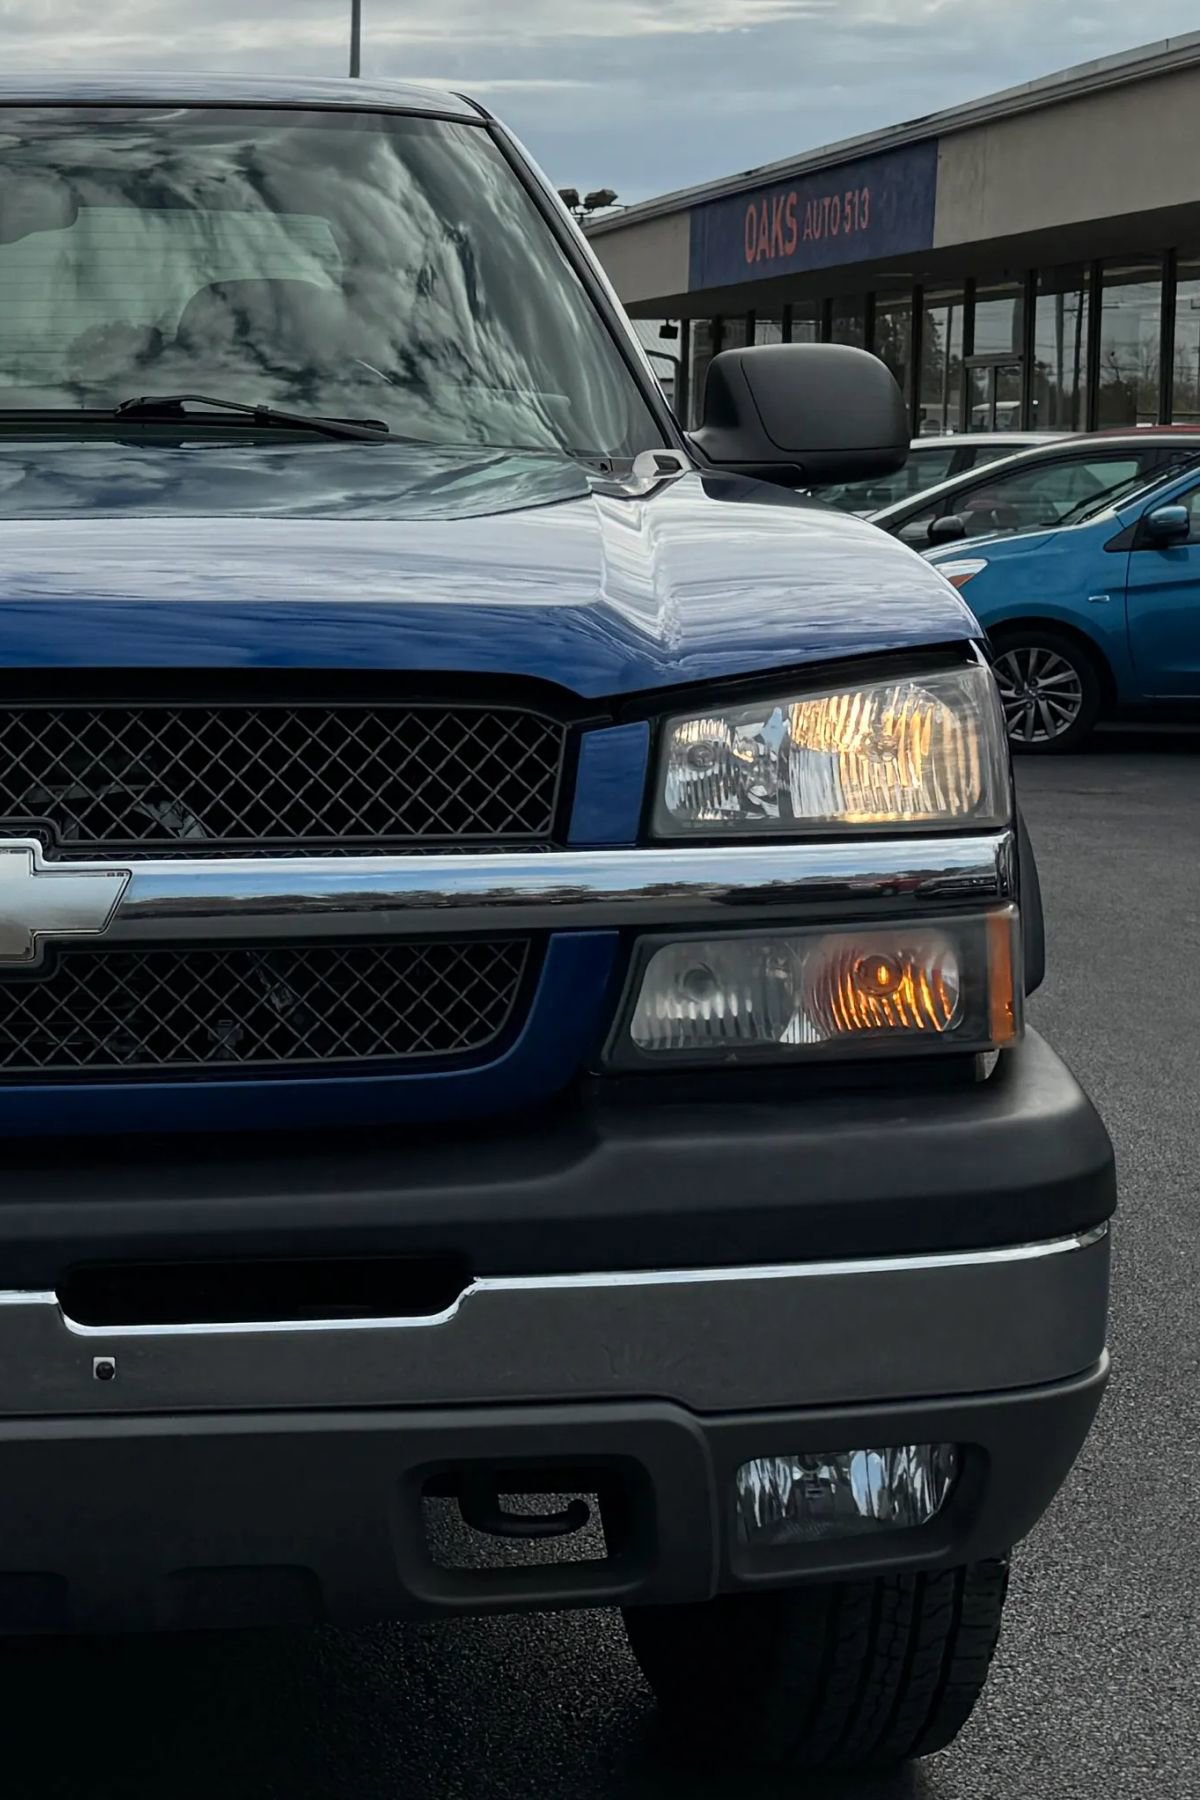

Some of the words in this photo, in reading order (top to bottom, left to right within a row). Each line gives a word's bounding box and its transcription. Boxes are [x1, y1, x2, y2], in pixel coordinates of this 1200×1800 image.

[745, 191, 798, 263] OAKS
[803, 195, 841, 240] AUTO
[843, 187, 870, 233] 513
